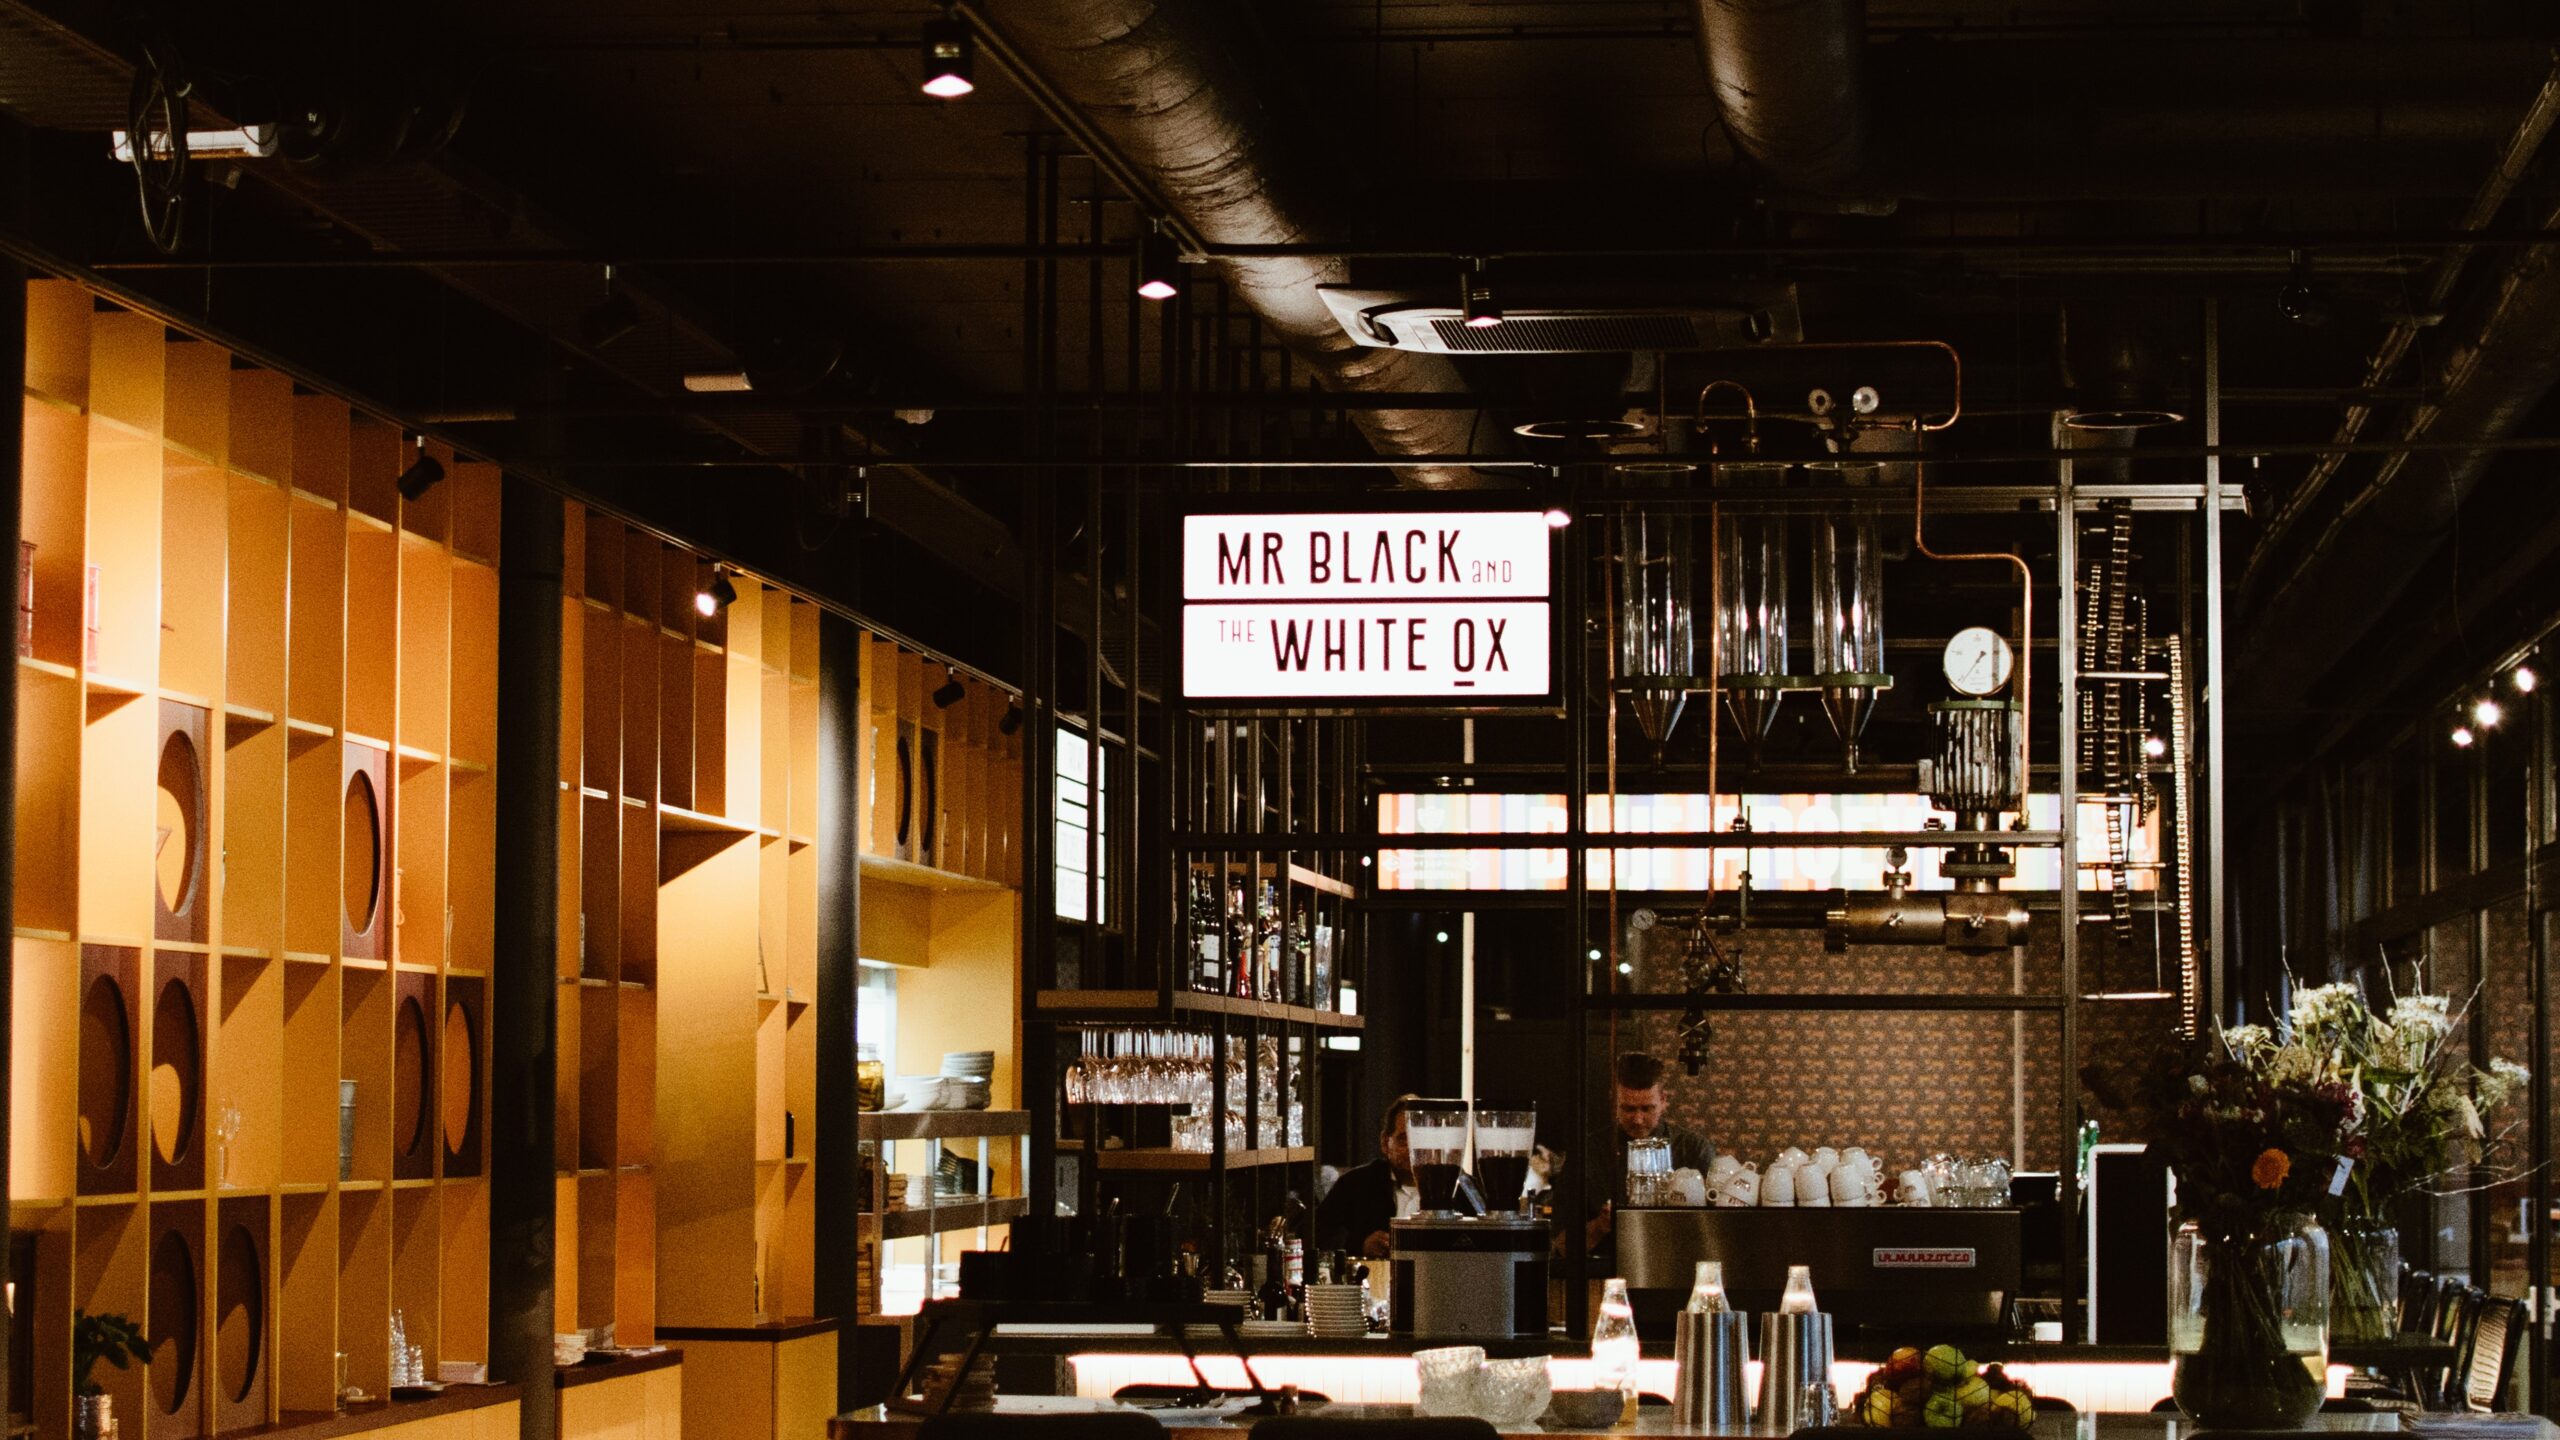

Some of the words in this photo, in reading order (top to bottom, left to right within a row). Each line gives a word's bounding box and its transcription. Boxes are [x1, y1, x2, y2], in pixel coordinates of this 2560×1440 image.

[1218, 531, 1285, 585] MR
[1309, 529, 1461, 584] BLACK
[1218, 619, 1255, 643] THE
[1270, 618, 1427, 672] WHITE
[1452, 618, 1509, 675] OX
